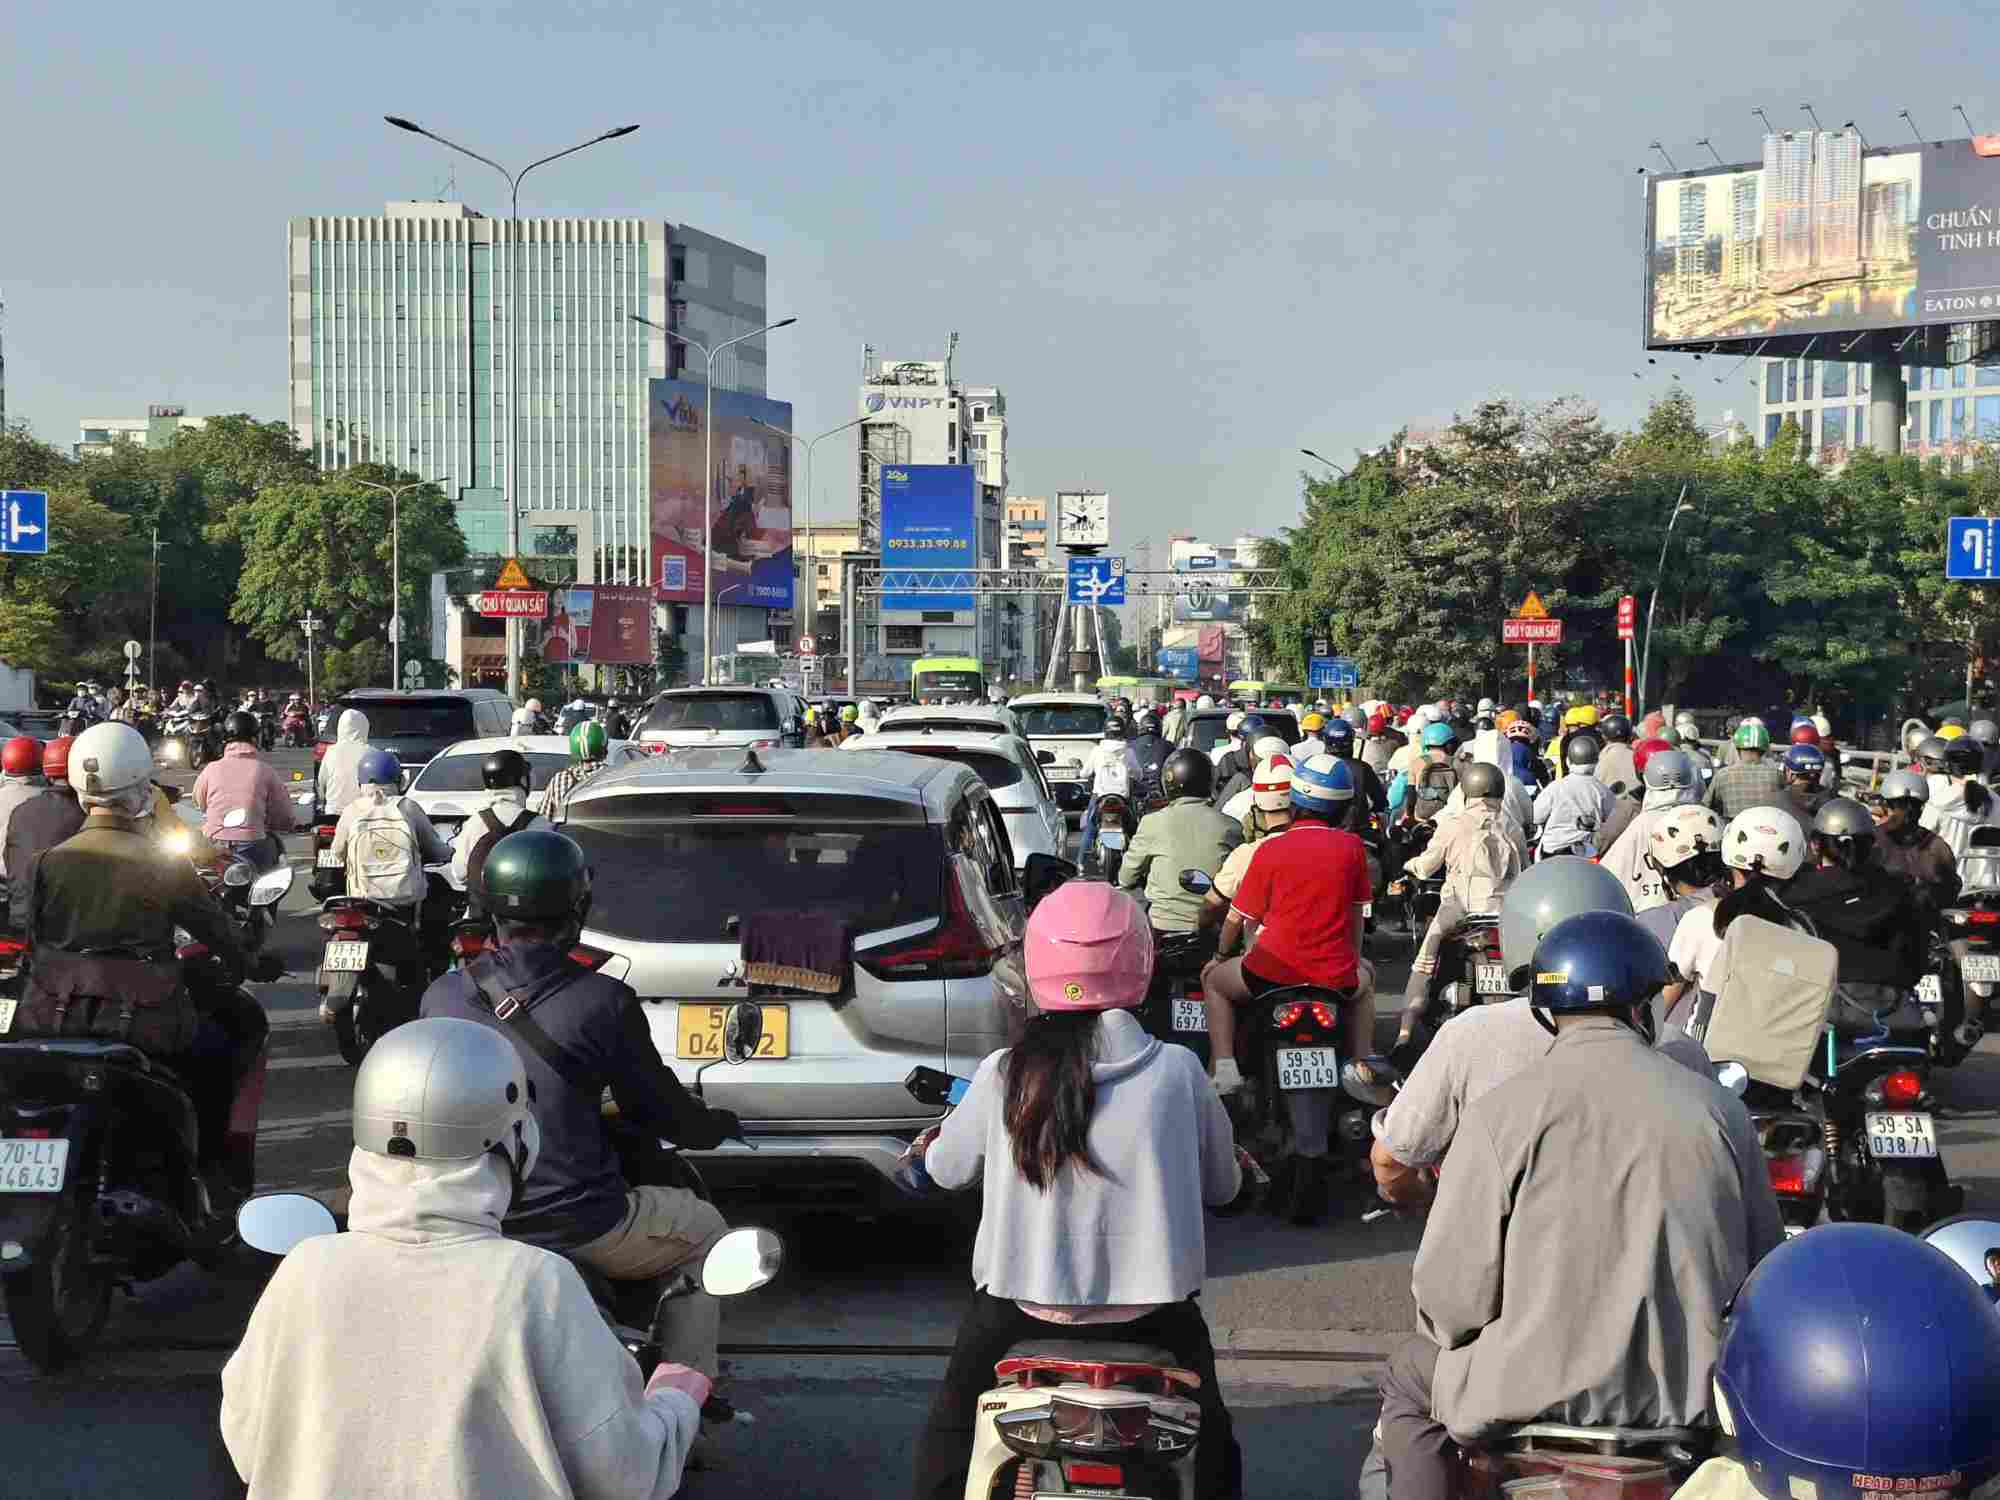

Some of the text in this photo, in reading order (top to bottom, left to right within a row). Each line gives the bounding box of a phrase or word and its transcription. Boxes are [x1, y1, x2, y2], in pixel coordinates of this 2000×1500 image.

[1937, 231, 1981, 251] TINH
[1925, 295, 1976, 312] EATON
[889, 398, 945, 409] VNPT
[505, 597, 528, 612] QUAN
[528, 594, 545, 613] SÁT
[1286, 1051, 1326, 1068] 59-S1
[1876, 1116, 1924, 1134] 59-SA
